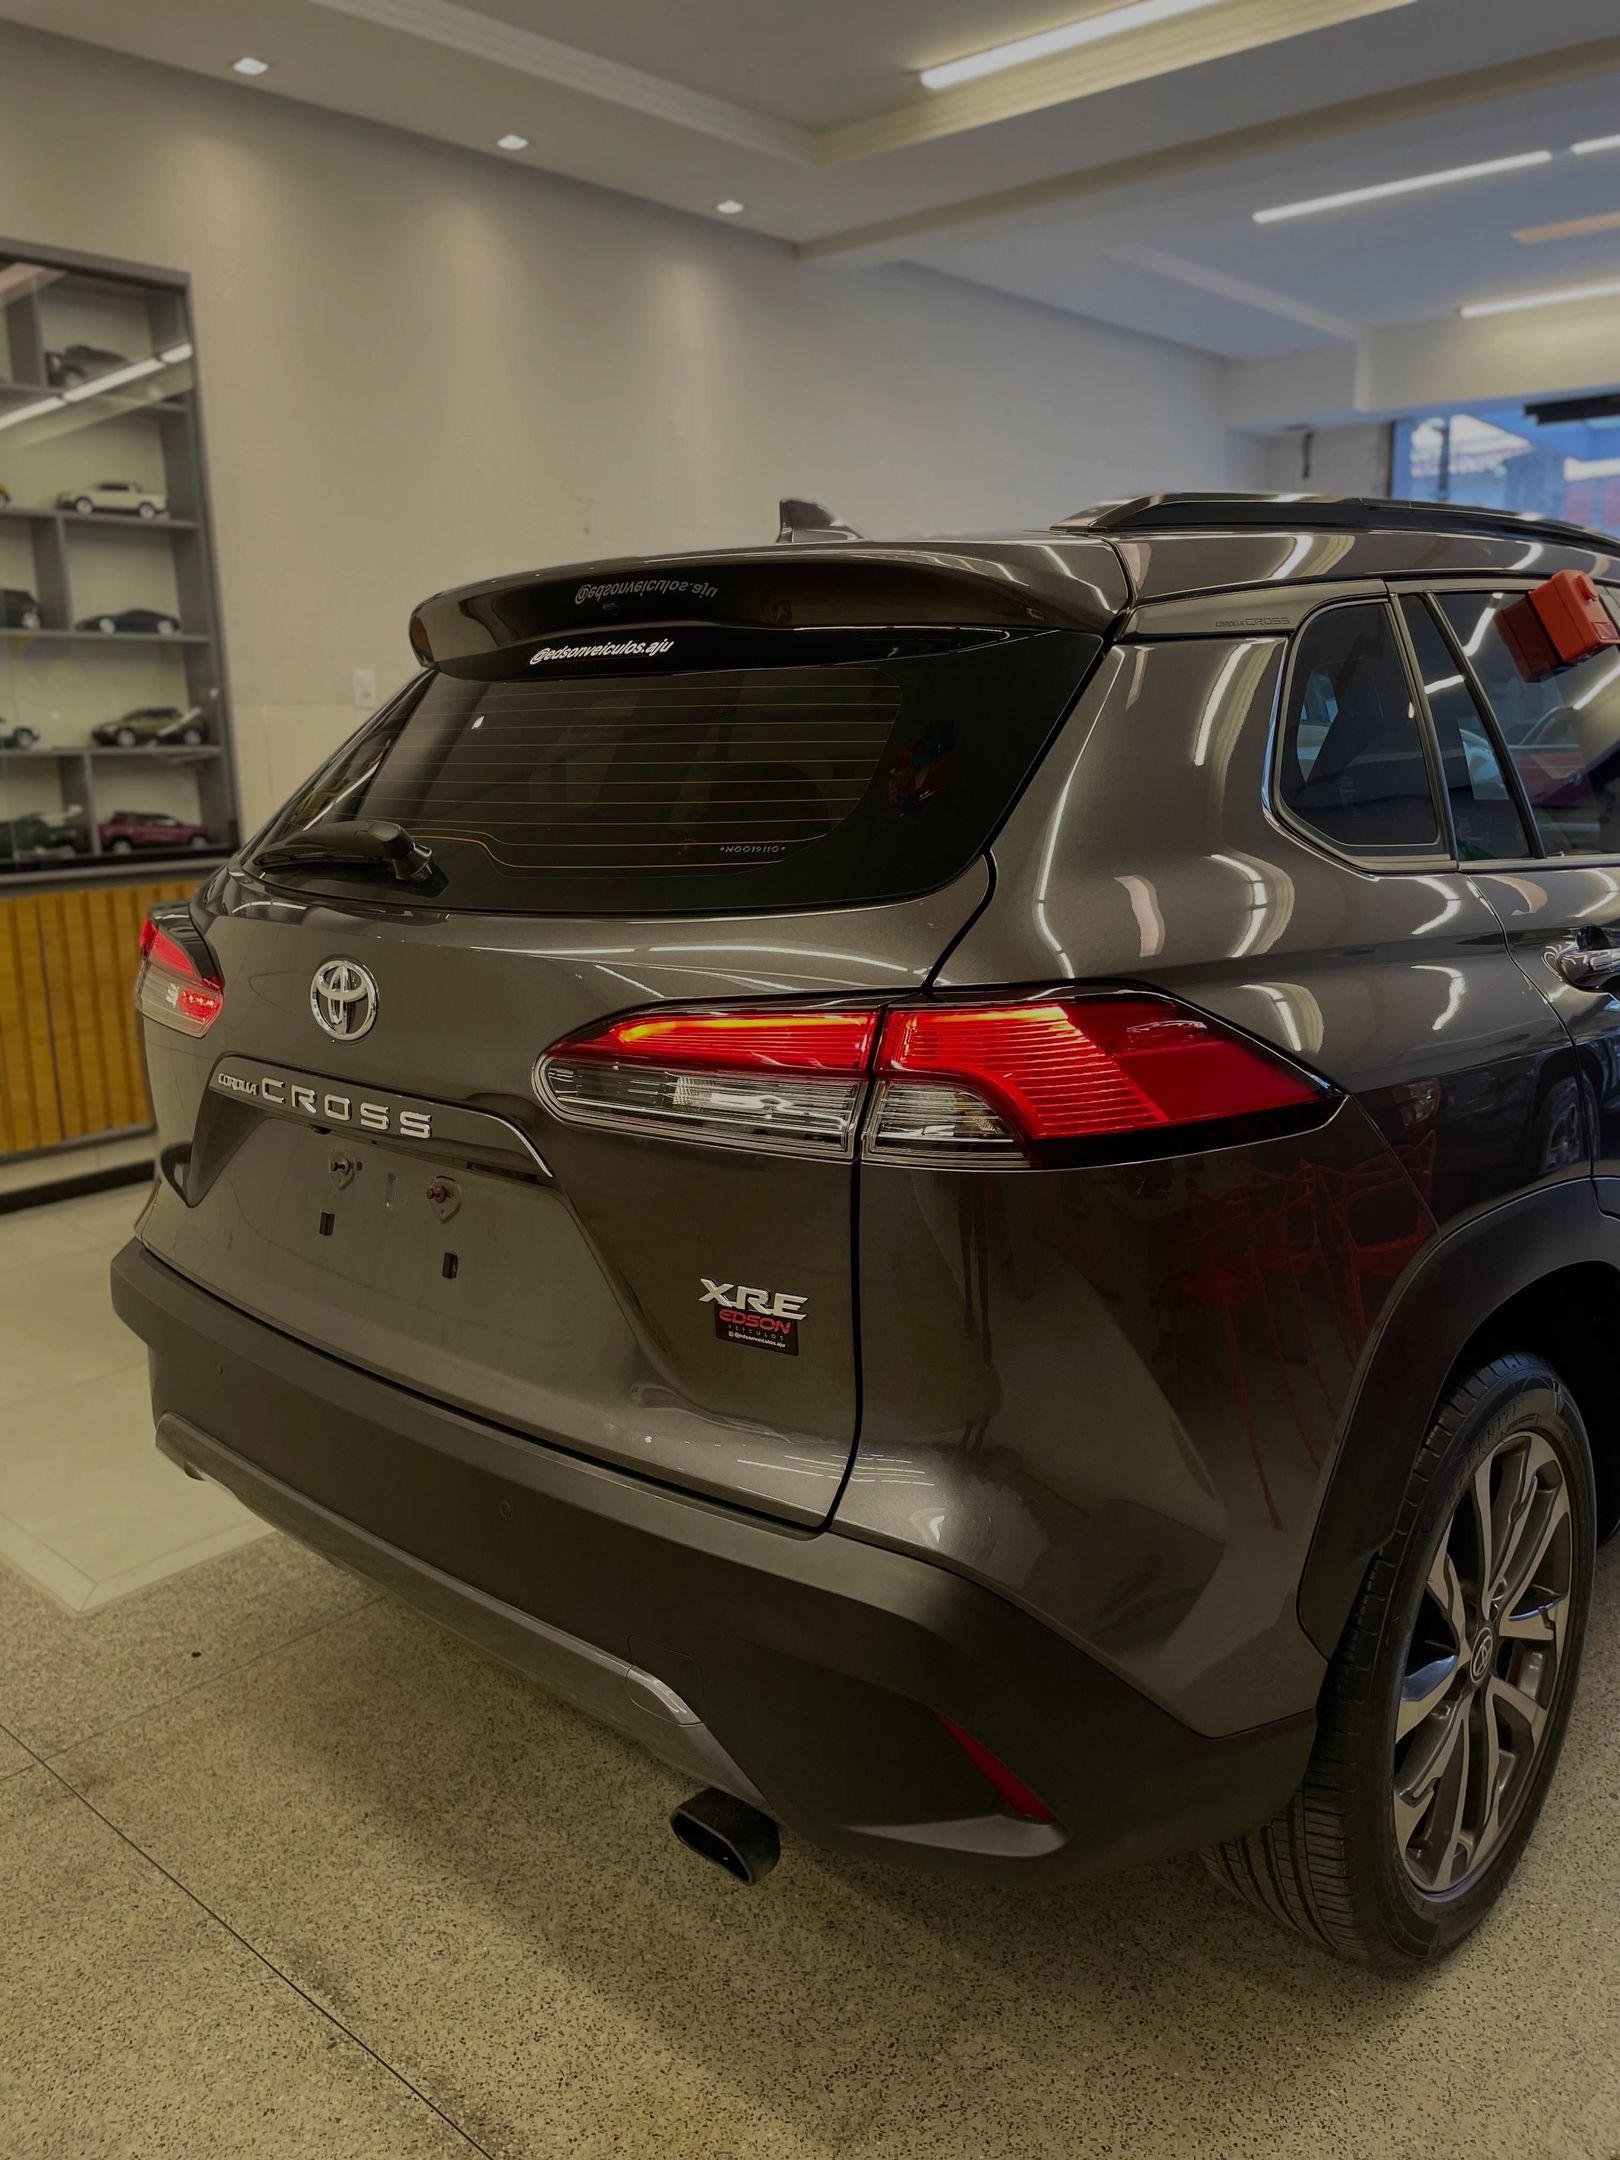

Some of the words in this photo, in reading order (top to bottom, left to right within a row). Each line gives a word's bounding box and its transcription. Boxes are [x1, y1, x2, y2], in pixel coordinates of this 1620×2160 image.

[1245, 616, 1290, 626] CROSS
[529, 638, 675, 665] @edsonveiculos.aju
[218, 1073, 259, 1096] COROLLA
[261, 1077, 433, 1139] CROSS
[698, 1278, 809, 1321] XRE
[720, 1309, 791, 1335] EDSON
[727, 1324, 784, 1341] VEICULOS
